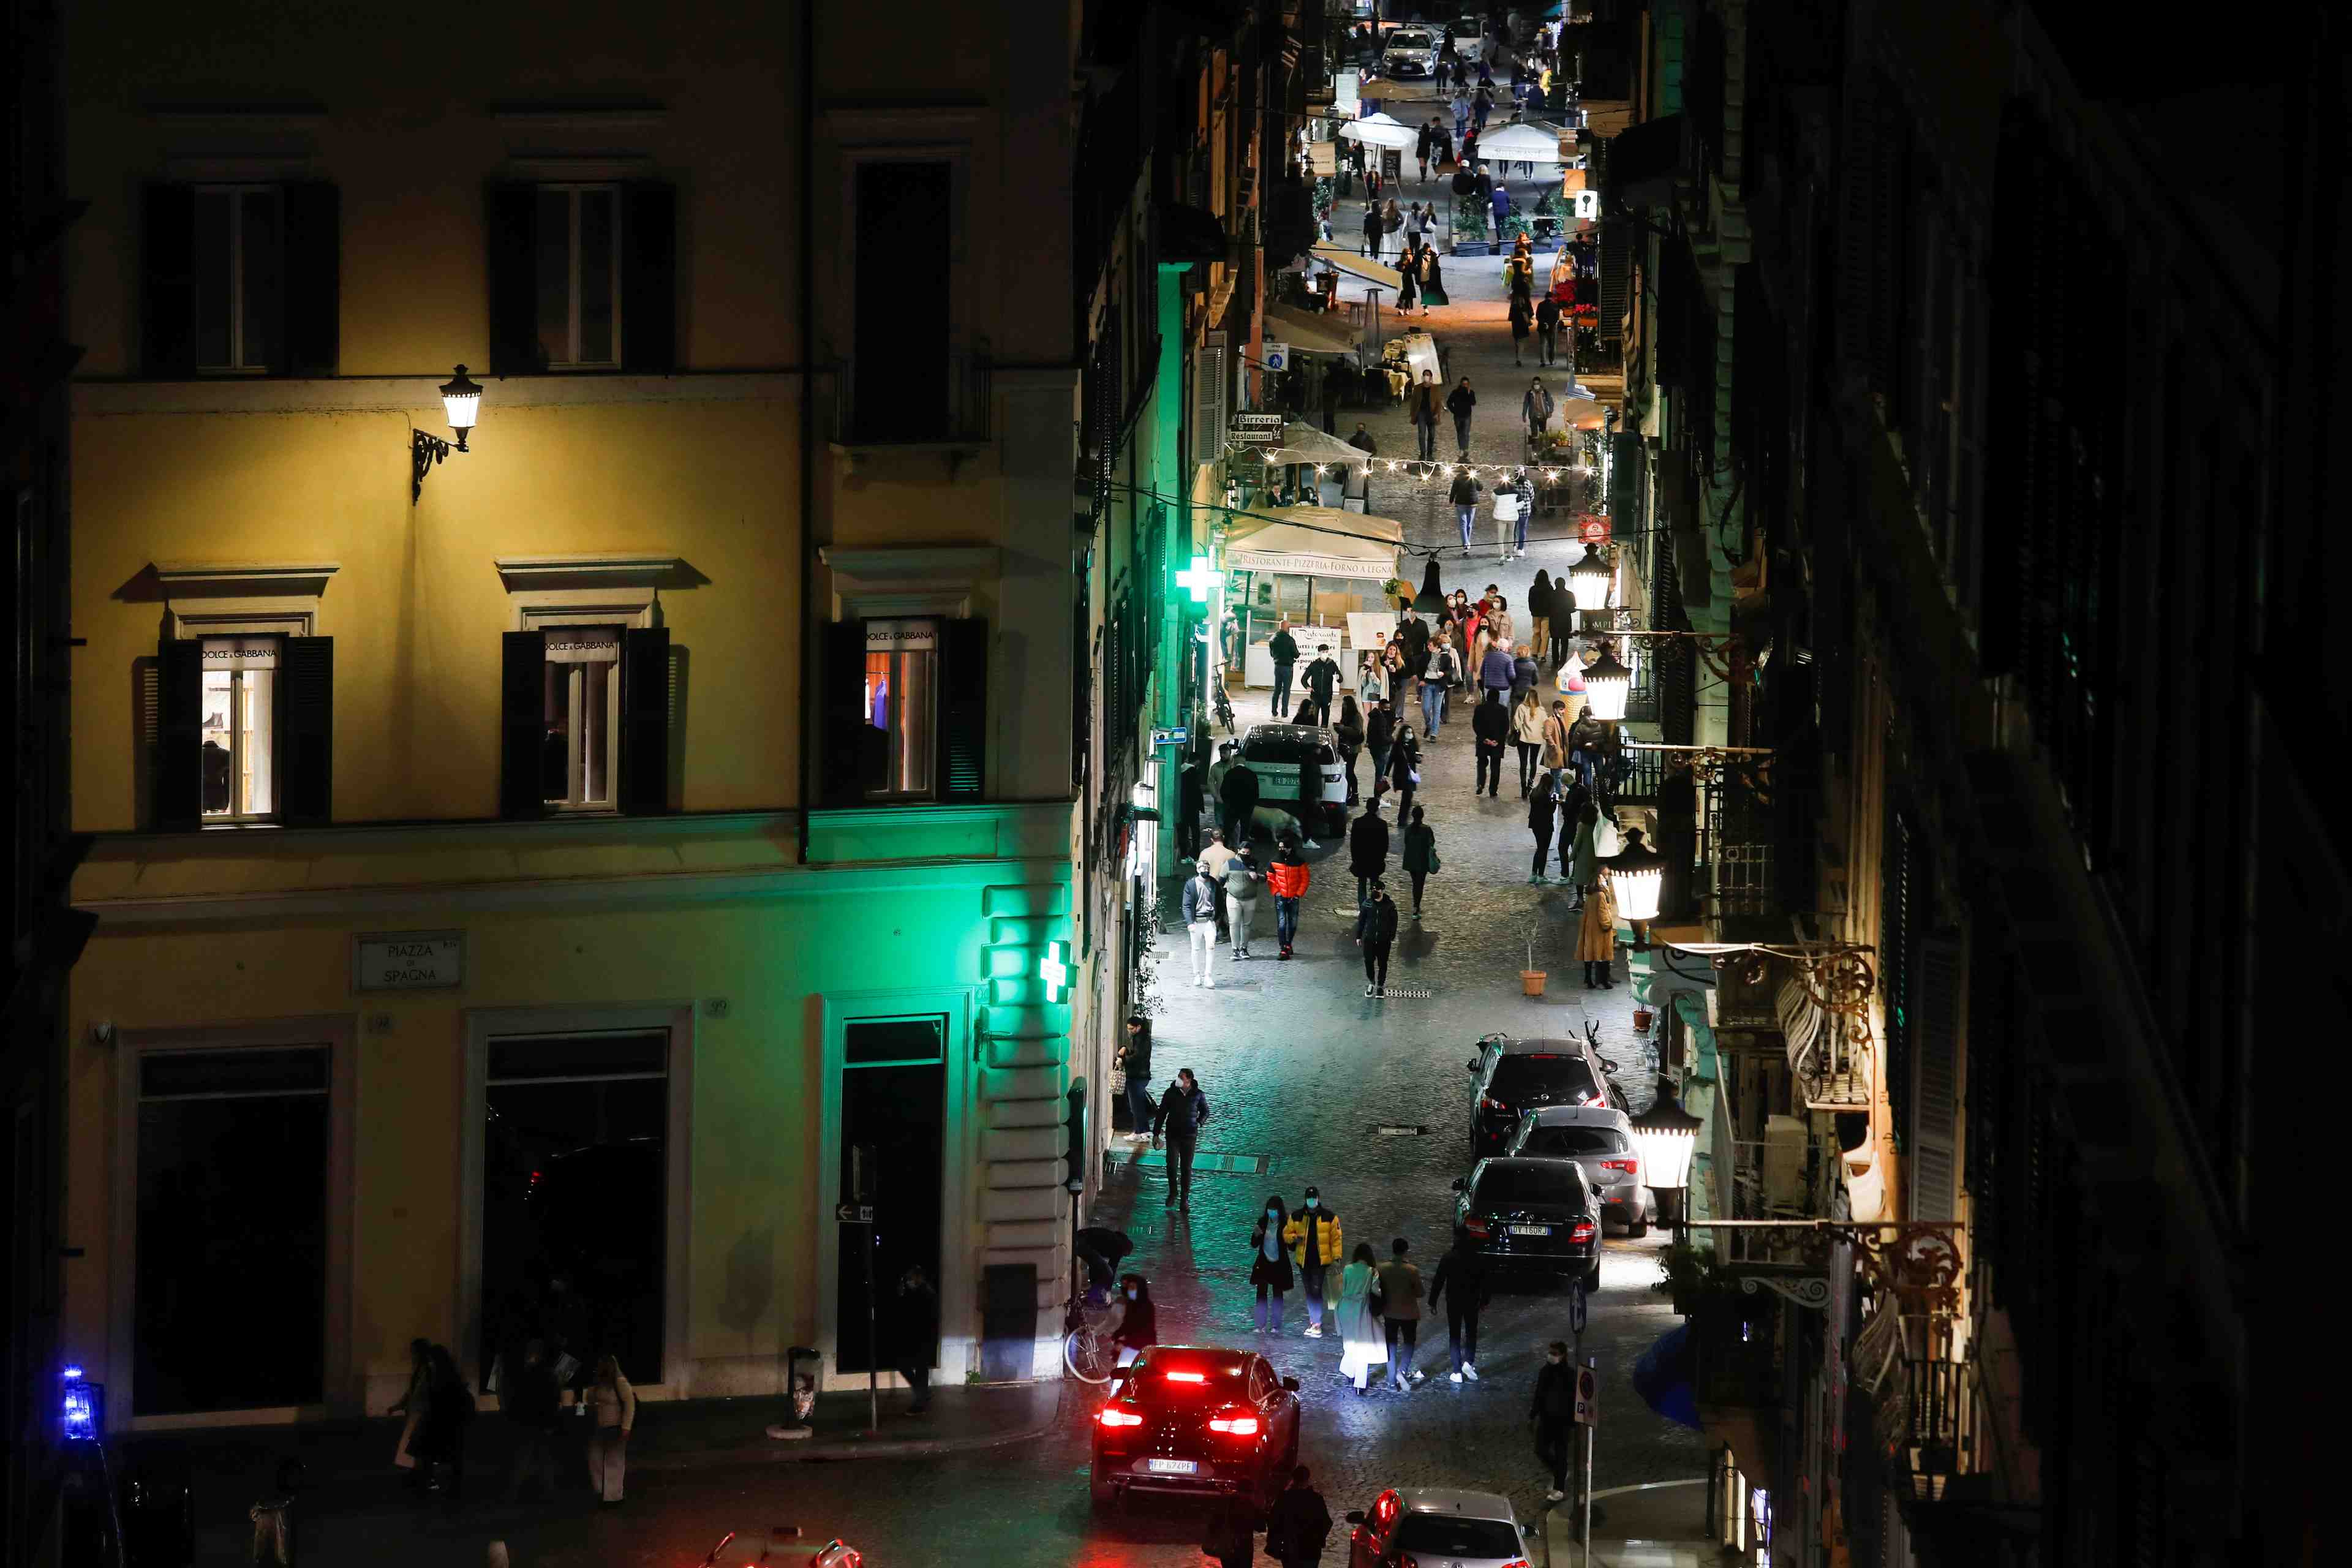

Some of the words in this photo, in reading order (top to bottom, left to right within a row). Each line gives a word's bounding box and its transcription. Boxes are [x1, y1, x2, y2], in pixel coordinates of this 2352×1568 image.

[1239, 415, 1280, 423] Birreria
[1231, 432, 1272, 440] Restaurant
[234, 649, 276, 658] GABBANA
[388, 944, 434, 957] PIAZZA
[385, 970, 437, 982] SPAGNA
